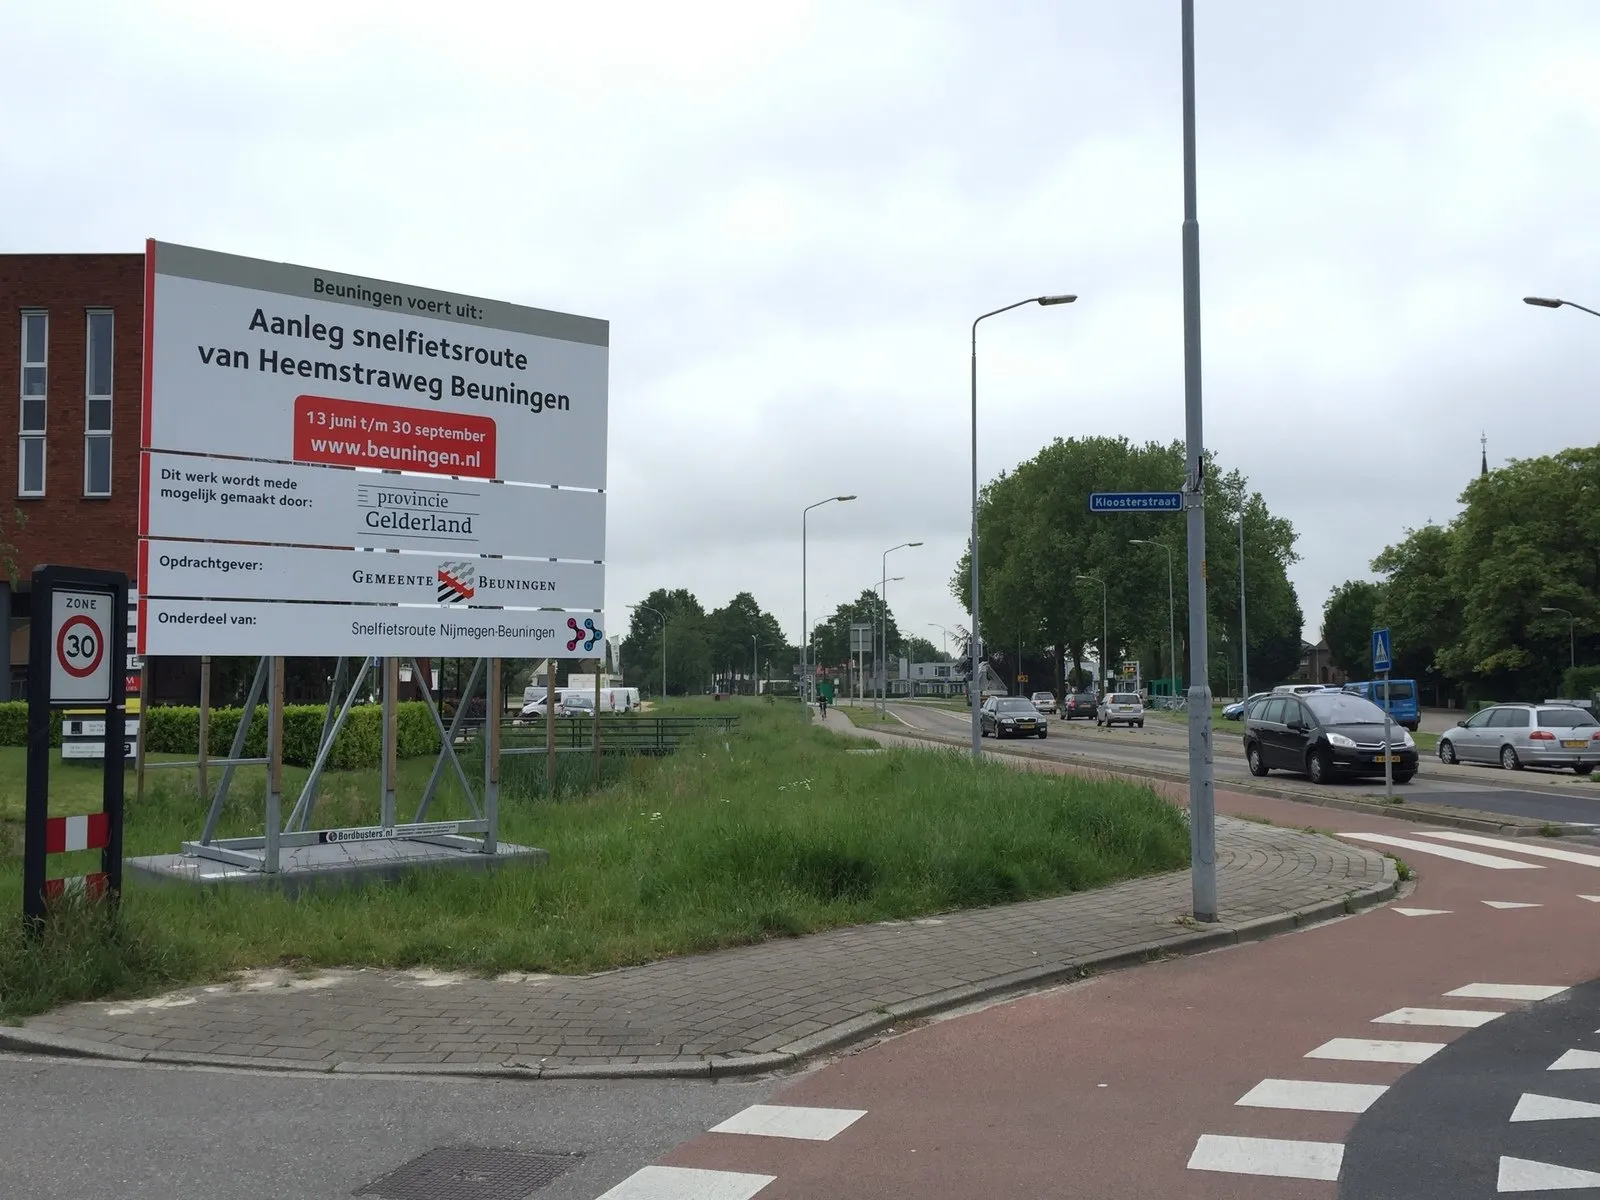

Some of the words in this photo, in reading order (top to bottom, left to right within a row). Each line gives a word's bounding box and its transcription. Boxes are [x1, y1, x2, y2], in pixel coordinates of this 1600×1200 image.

[314, 277, 402, 307] Beuningen
[408, 296, 451, 315] voert
[457, 301, 483, 320] uit:
[249, 309, 344, 349] Aanleg
[353, 326, 528, 370] snelfietsroute
[198, 346, 249, 369] van
[259, 349, 443, 400] Heemstraweg
[451, 375, 570, 413] Beuningen
[306, 411, 326, 426] 13
[328, 413, 357, 432] juni
[360, 417, 388, 433] t/m
[393, 421, 411, 435] 30
[414, 423, 486, 444] september
[311, 437, 481, 468] www.beuningen.nl
[161, 469, 181, 481] Dit
[186, 471, 217, 484] werk
[222, 474, 260, 487] wordt
[264, 477, 297, 490] mede
[161, 486, 217, 502] mogelijk
[220, 492, 275, 505] gemaakt
[279, 496, 313, 507] door:
[377, 491, 449, 510] provincie
[1095, 497, 1177, 506] Kloosterstraat
[365, 512, 472, 534] Gelderland
[159, 556, 263, 572] Opdrachtgever:
[352, 570, 433, 587] GEMEENTE
[479, 577, 556, 592] BEUNINGEN
[66, 598, 97, 610] ZONE
[158, 613, 227, 625] Onderdeel
[230, 615, 256, 626] van:
[352, 621, 436, 636] Snelfietsroute
[440, 625, 555, 640] Nijmegen-Beuningen
[66, 635, 95, 658] 30
